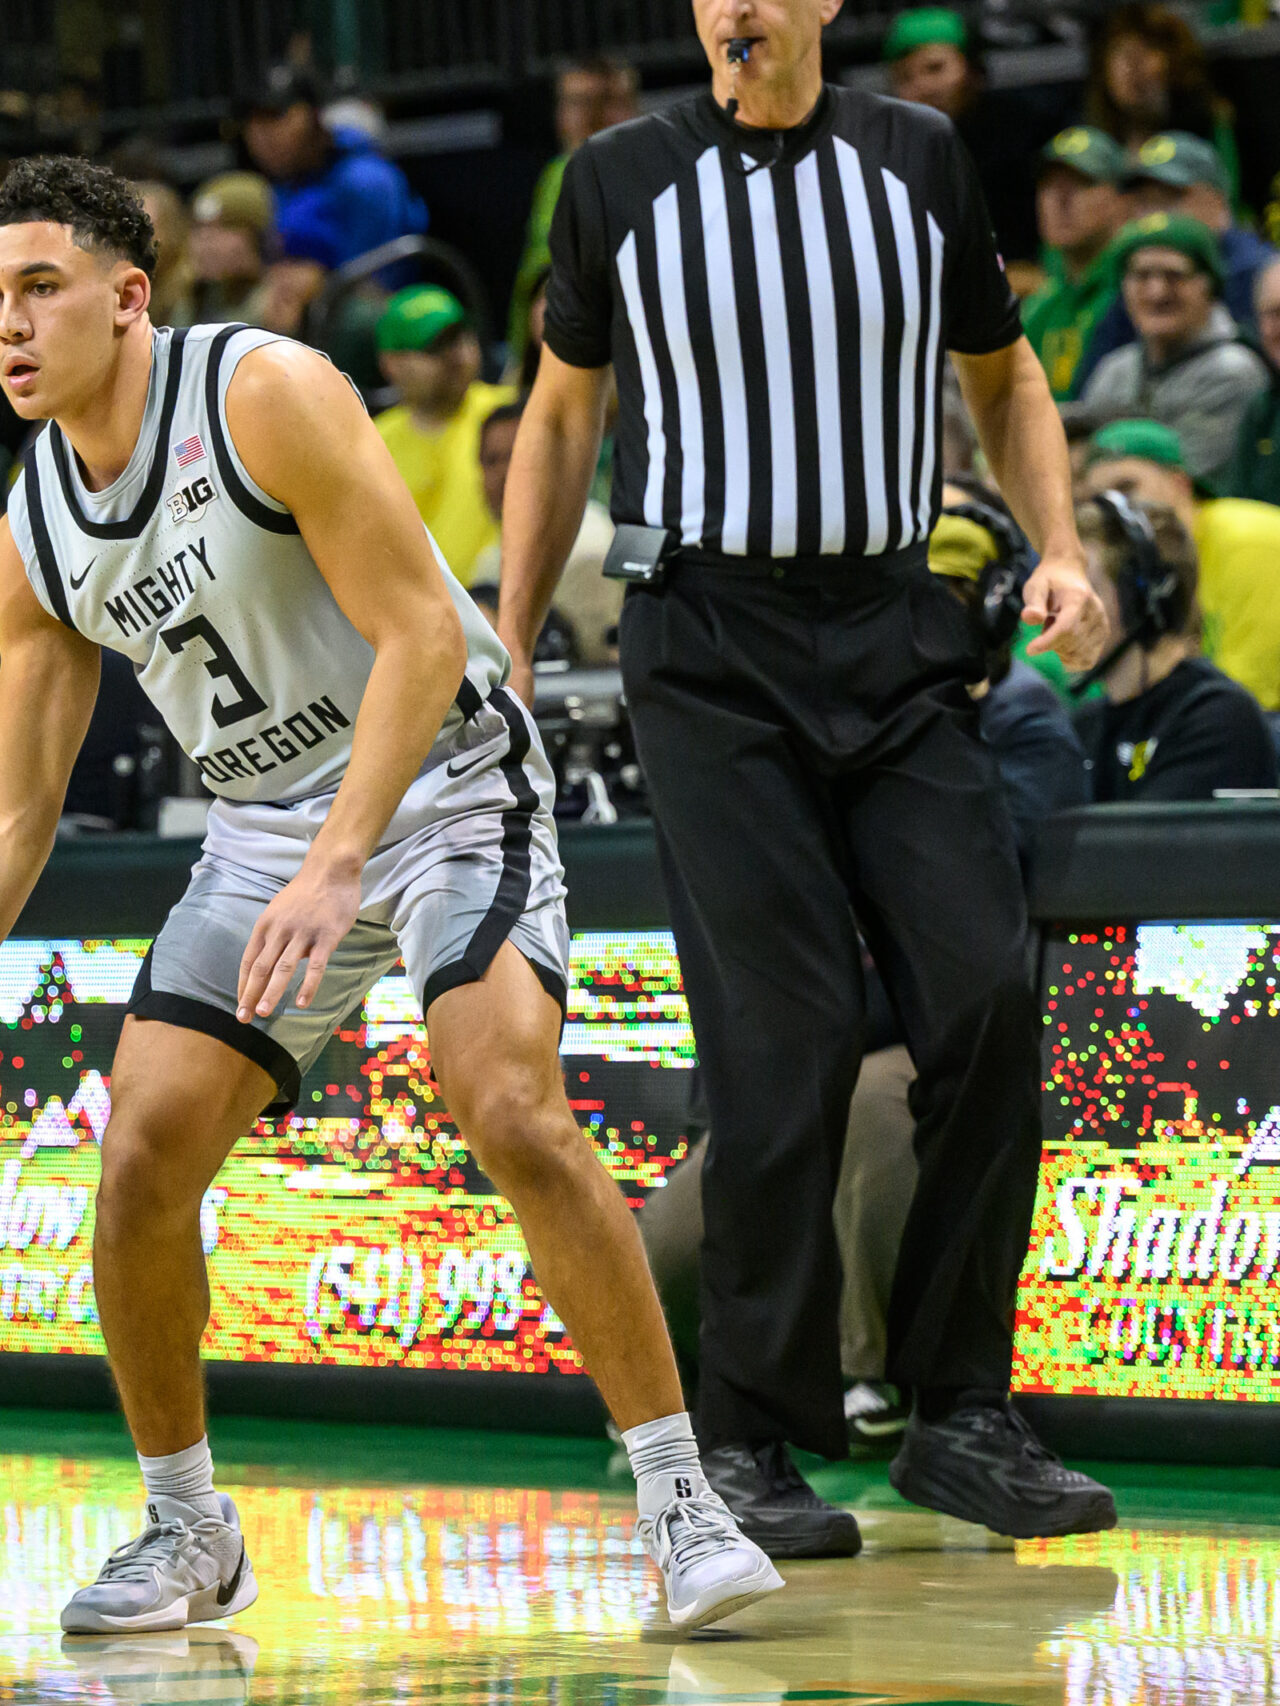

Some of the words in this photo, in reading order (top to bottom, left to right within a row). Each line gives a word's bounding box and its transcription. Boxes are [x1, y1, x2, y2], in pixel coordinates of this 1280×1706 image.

[104, 536, 216, 638] MIGHTY
[158, 613, 269, 729] 3
[195, 695, 351, 783] OREGON
